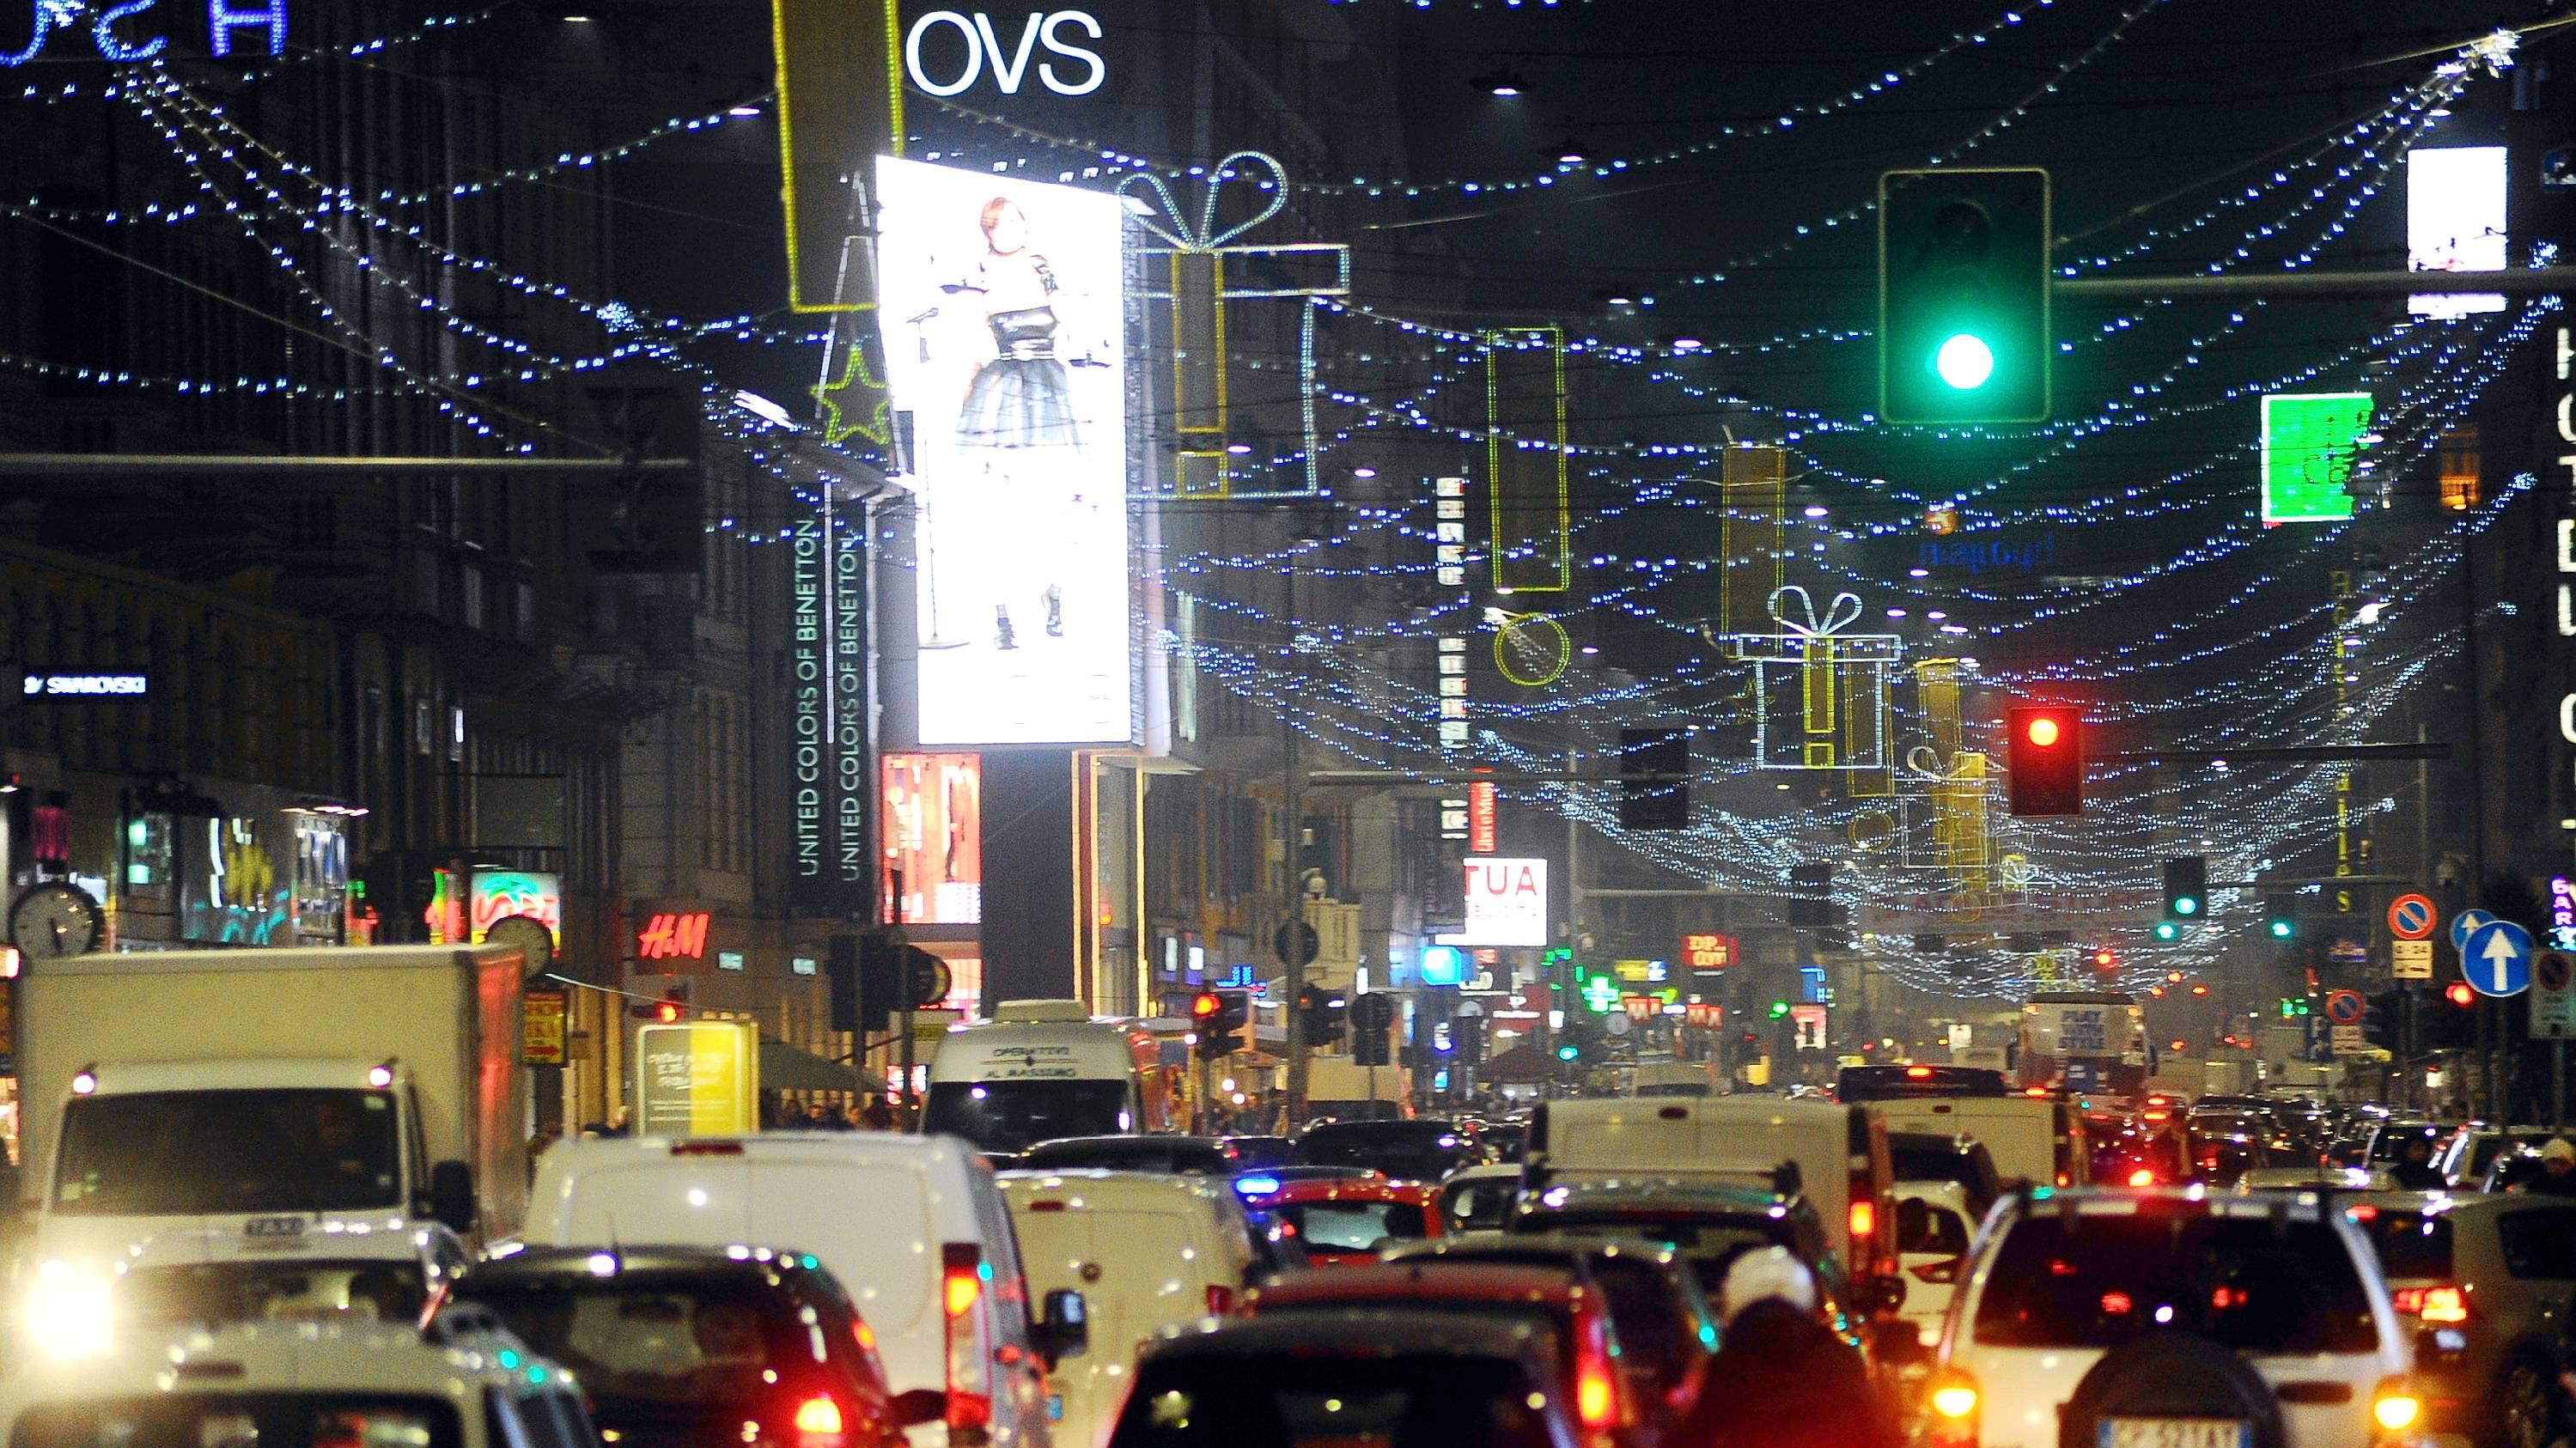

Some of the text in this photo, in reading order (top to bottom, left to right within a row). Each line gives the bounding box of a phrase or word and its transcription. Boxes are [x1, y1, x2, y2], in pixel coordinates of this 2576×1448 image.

[906, 10, 1105, 96] OVS
[795, 648, 818, 681] OF
[838, 661, 860, 693] OF
[796, 686, 819, 782] COLORS
[839, 697, 861, 791] COLORS
[797, 788, 819, 876] UNITED
[840, 796, 861, 881] UNITED
[1464, 865, 1538, 897] TUA
[639, 914, 709, 959] H&M
